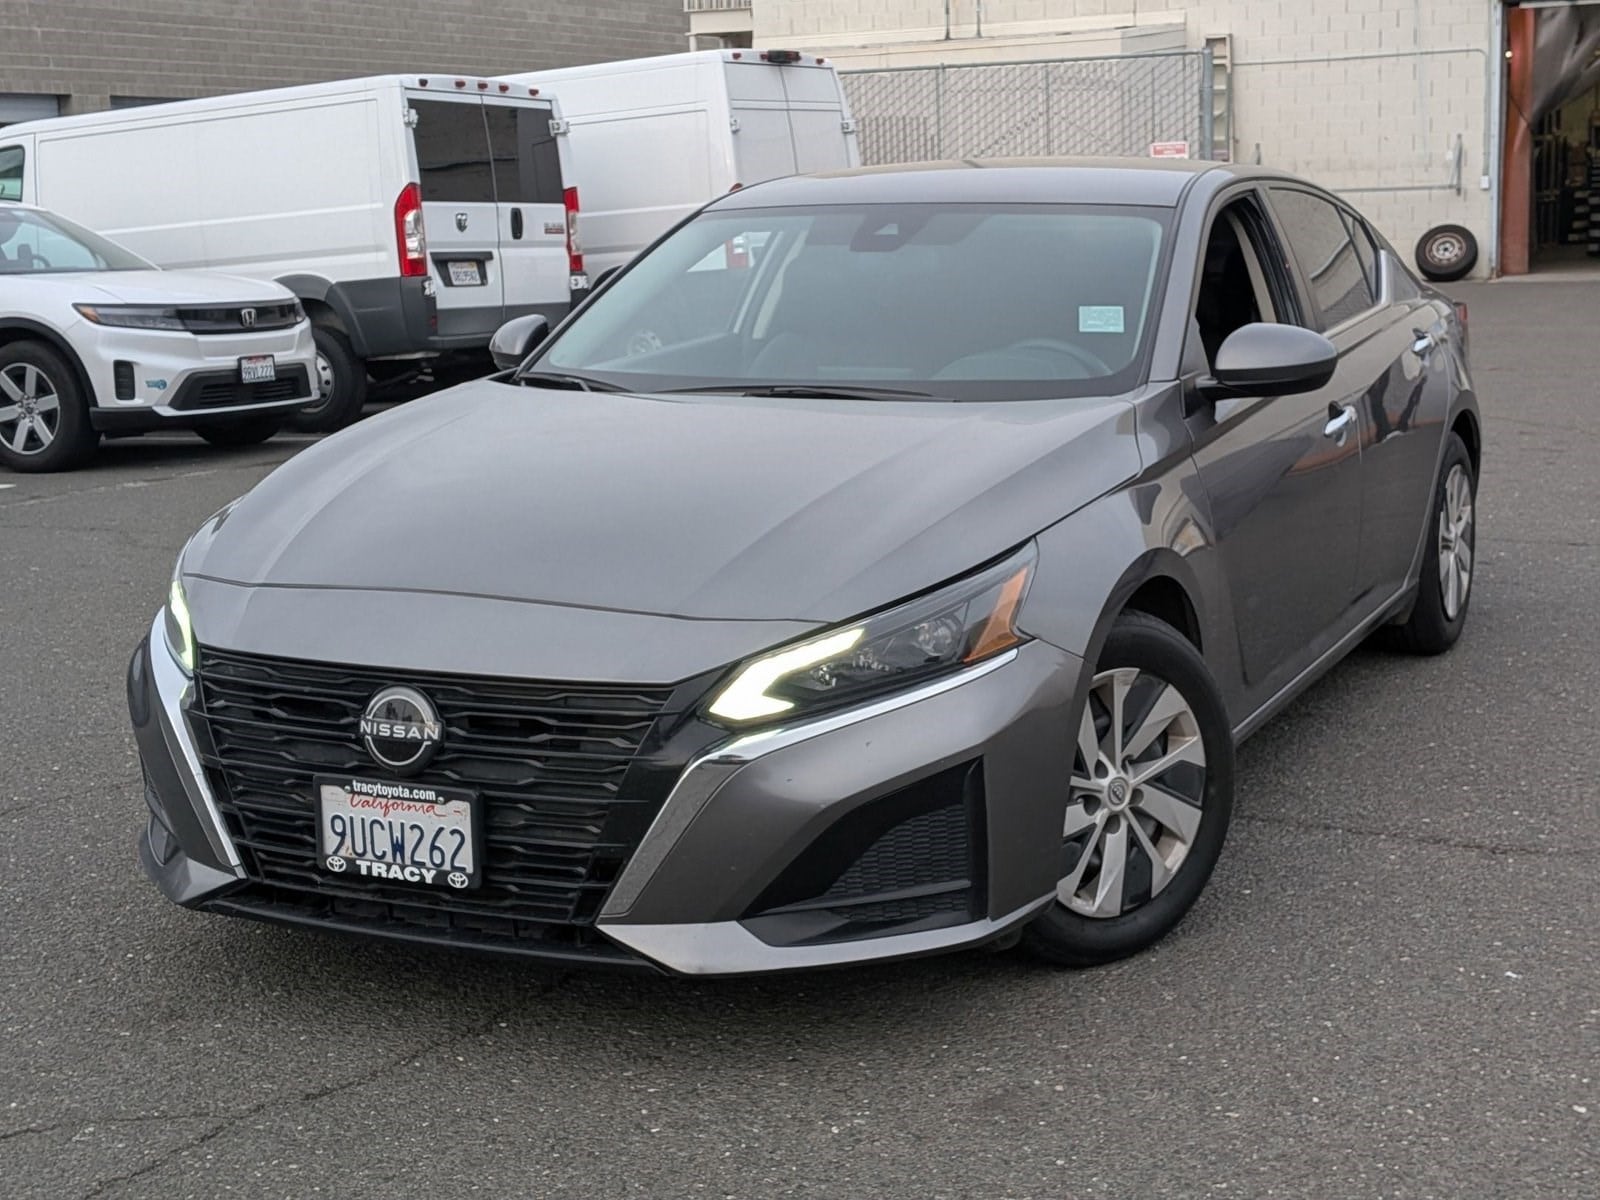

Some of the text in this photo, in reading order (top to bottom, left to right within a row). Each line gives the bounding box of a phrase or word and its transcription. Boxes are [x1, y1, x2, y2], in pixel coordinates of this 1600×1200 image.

[360, 720, 440, 740] NISSAN
[353, 780, 436, 801] tracytoyota.com
[349, 794, 447, 817] California
[330, 814, 467, 871] 9UCW262
[356, 859, 437, 884] TRACY
